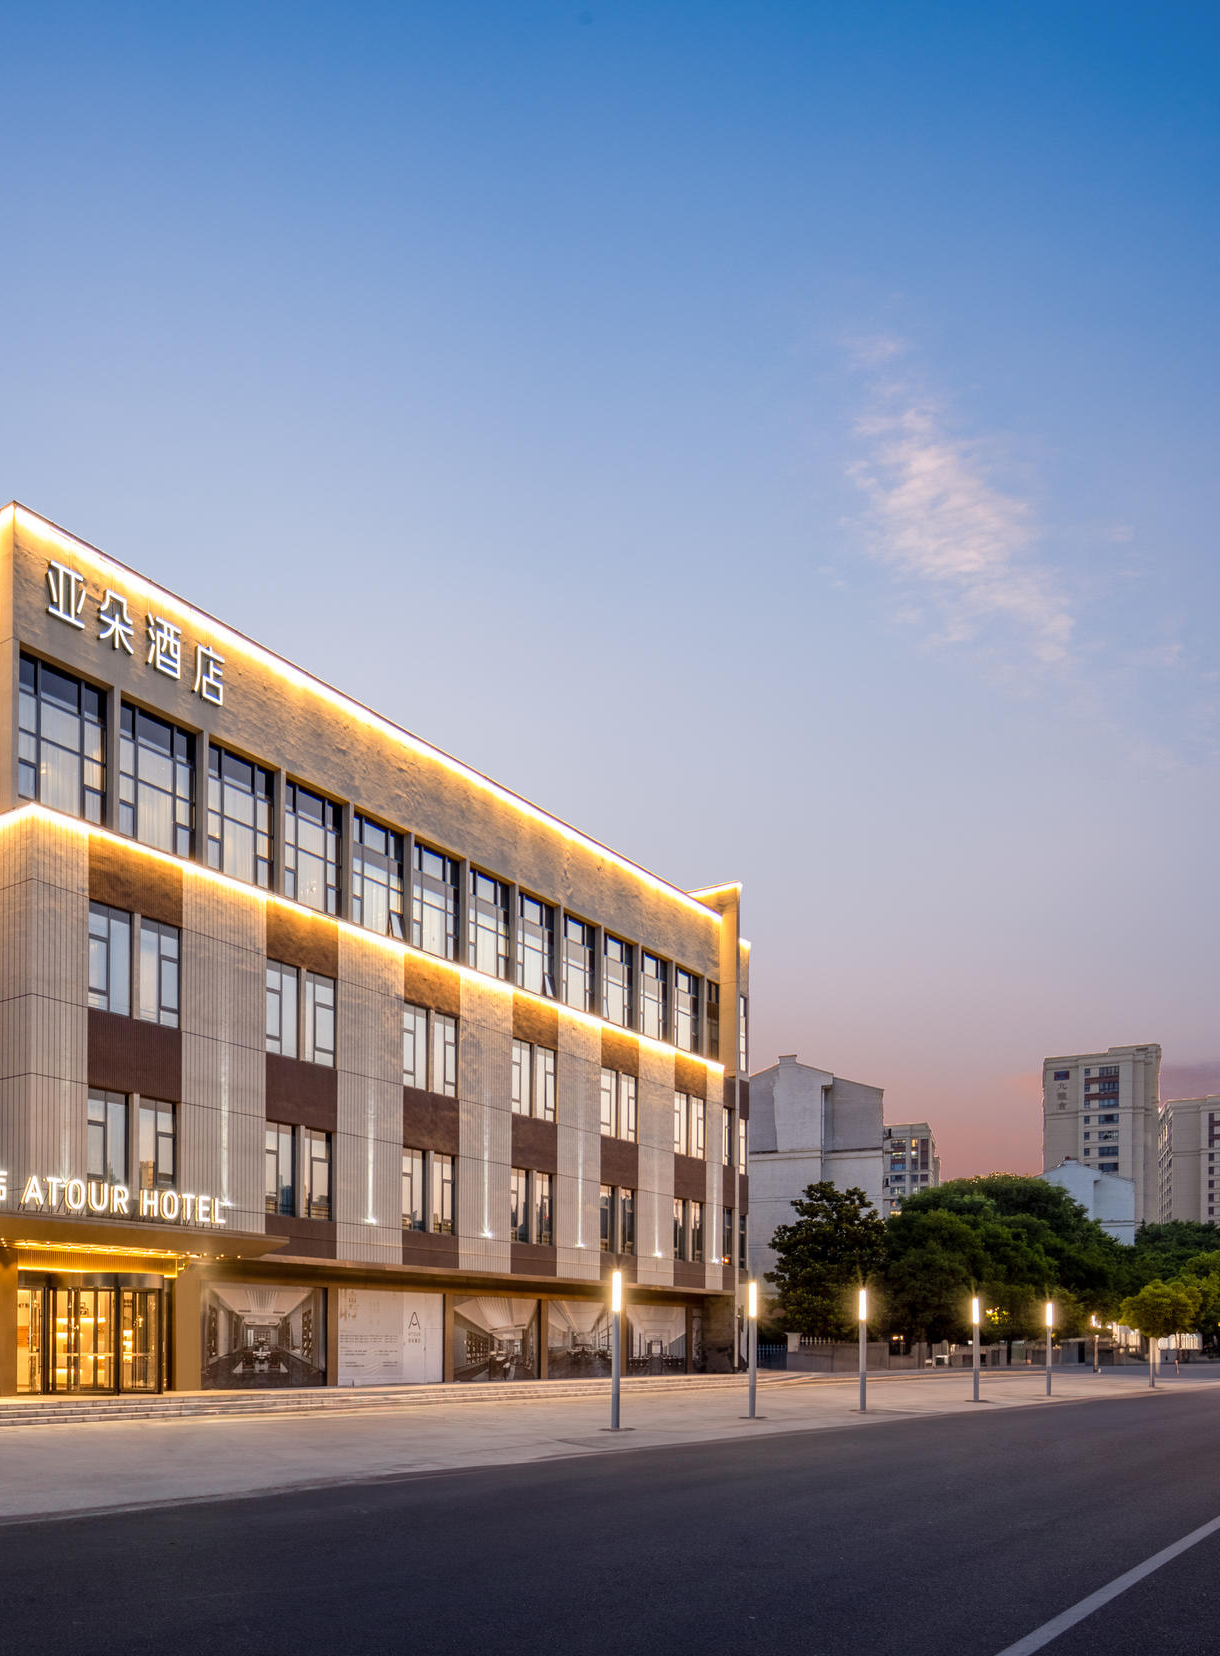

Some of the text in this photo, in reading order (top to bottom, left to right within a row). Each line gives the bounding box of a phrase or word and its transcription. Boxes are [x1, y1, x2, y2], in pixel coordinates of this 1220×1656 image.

[47, 560, 225, 706] 亚朵酒店
[21, 1175, 129, 1215] ATOUR
[140, 1189, 226, 1224] HOTEL
